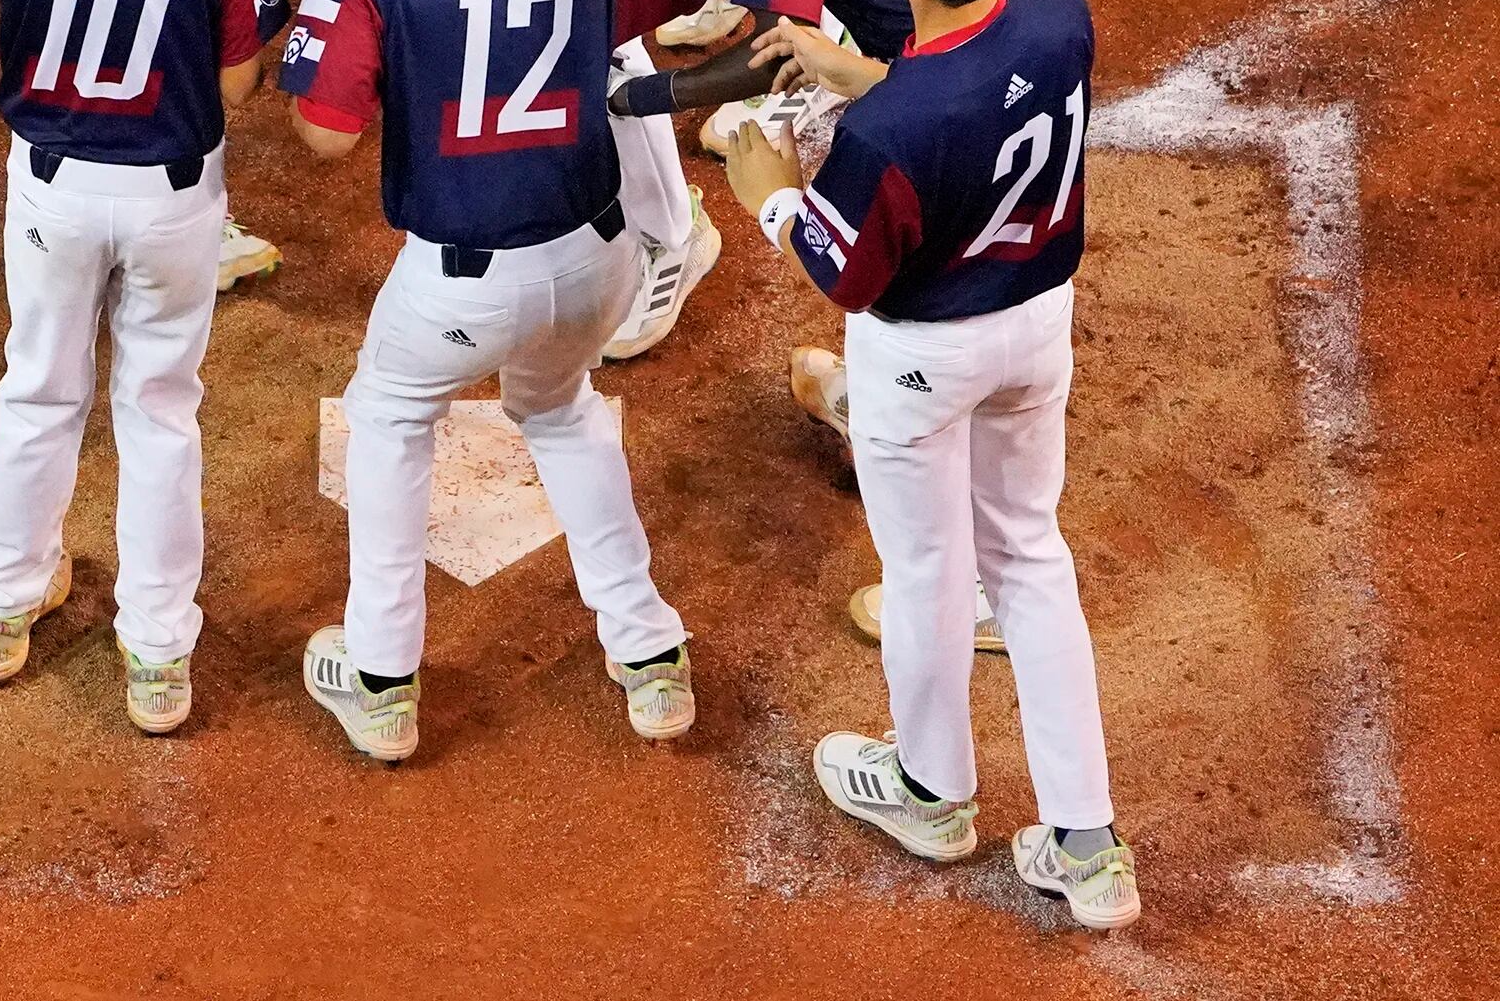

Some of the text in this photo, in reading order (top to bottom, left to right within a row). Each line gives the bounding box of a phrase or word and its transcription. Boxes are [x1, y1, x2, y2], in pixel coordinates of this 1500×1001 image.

[1004, 81, 1034, 109] adidas
[962, 79, 1084, 258] 21
[441, 333, 477, 348] adidas
[895, 377, 932, 393] adidas
